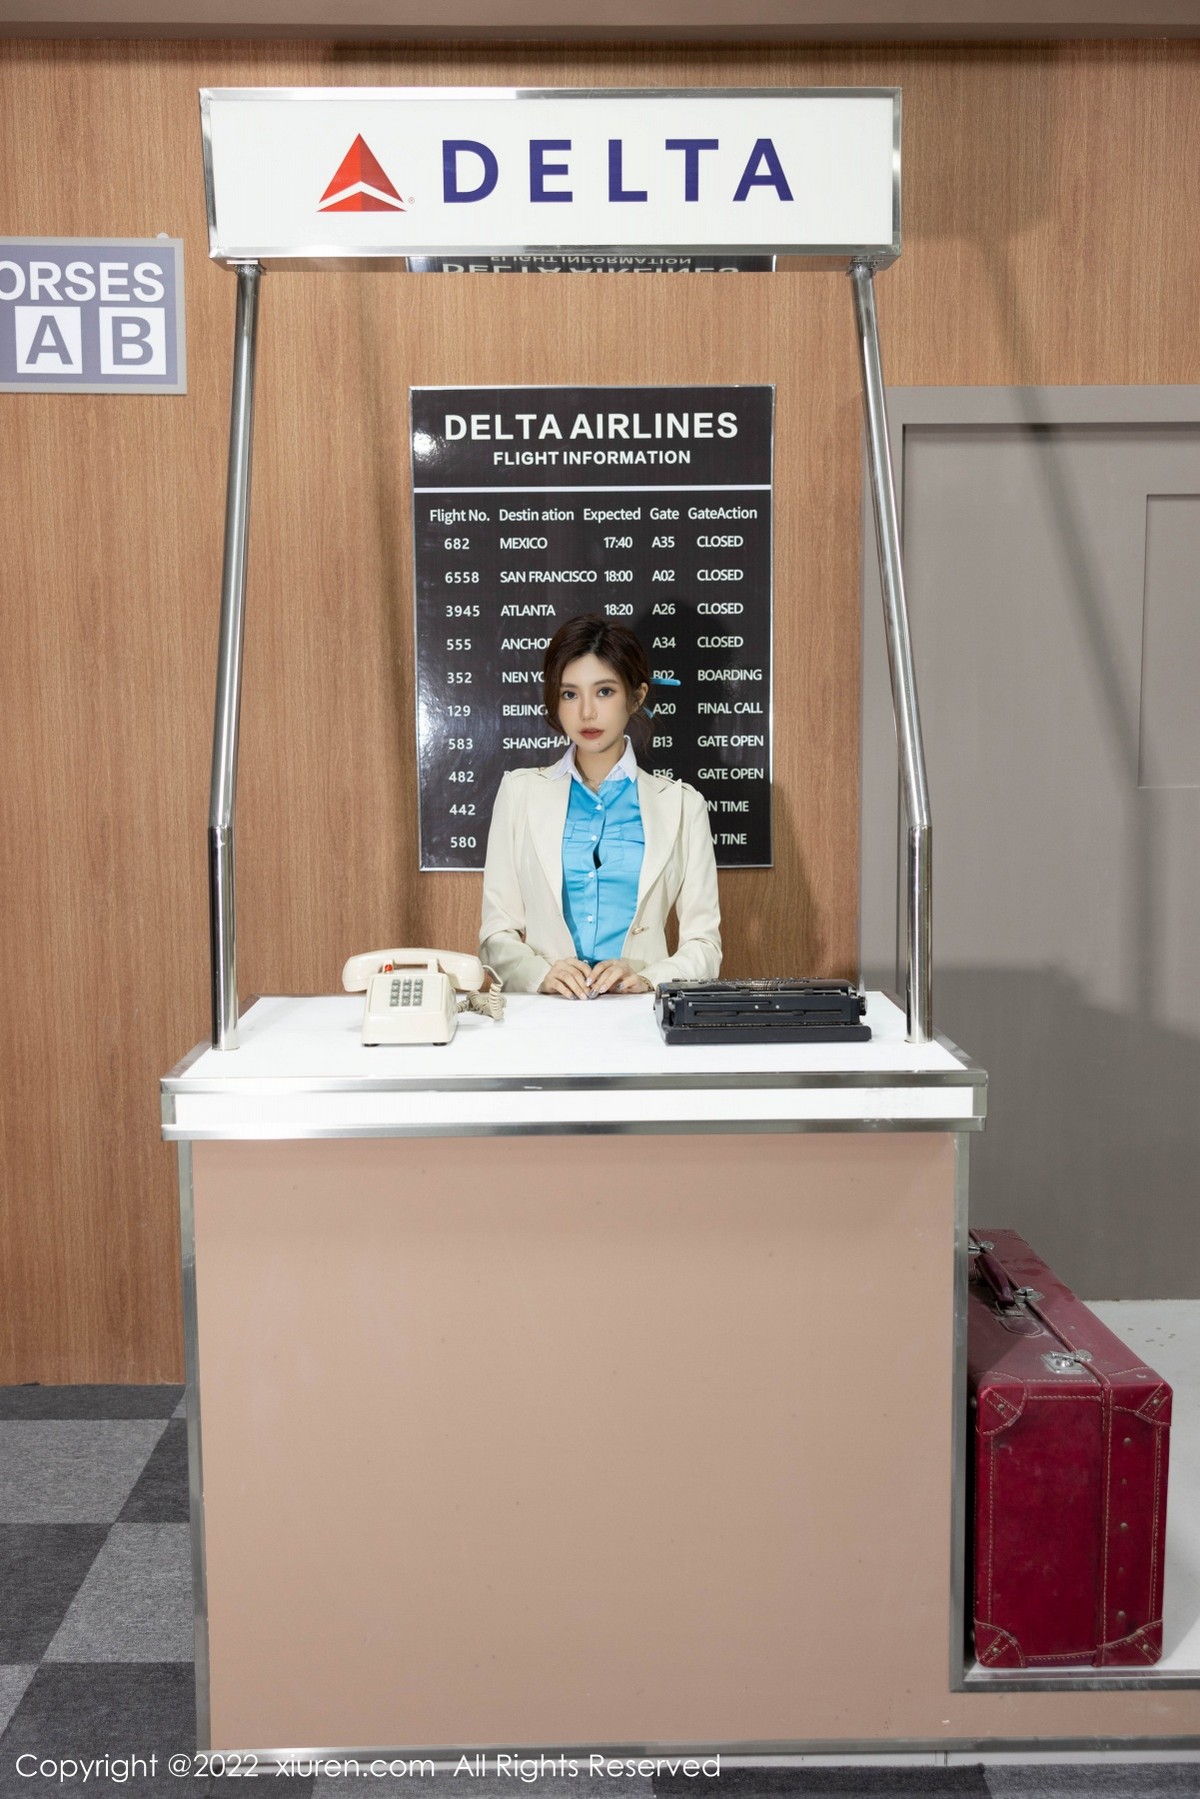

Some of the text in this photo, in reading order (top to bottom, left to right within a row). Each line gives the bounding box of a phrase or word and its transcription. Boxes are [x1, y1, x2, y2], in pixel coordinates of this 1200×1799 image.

[442, 138, 794, 204] DELTA
[0, 261, 165, 302] ORSES
[25, 315, 153, 366] A B
[444, 412, 737, 440] DELTA AIRLINES
[494, 451, 690, 465] FLIGHT INFORMATION
[430, 509, 466, 525] Flight
[469, 510, 490, 521] No.
[584, 507, 640, 523] Expected
[650, 508, 679, 520] Gate
[688, 507, 757, 519] GateAction
[445, 536, 743, 549] 682 MEXICO 17:40 A35 CLOSED
[445, 569, 743, 583] 6558 SAN FRANCISCO 18:00 A02 CLOSED
[446, 603, 743, 617] 3945 ATLANTA 18:20 A26 CLOSED
[447, 636, 743, 650] 555 ANCHO A34 CLOSED
[447, 672, 471, 683] 352
[502, 672, 527, 683] NEN
[698, 669, 762, 681] BOARDING
[448, 703, 763, 717] 129 BEIJING A20 FINAL CALL
[449, 738, 473, 750] 583
[653, 736, 672, 747] B13
[698, 736, 728, 747] GATE
[730, 735, 763, 746] OPEN
[449, 771, 474, 782] 482
[698, 768, 728, 779] GATE
[731, 768, 763, 779] OPEN
[450, 800, 749, 815] 442 N TIME
[451, 837, 476, 848] 580
[720, 834, 746, 844] TINE
